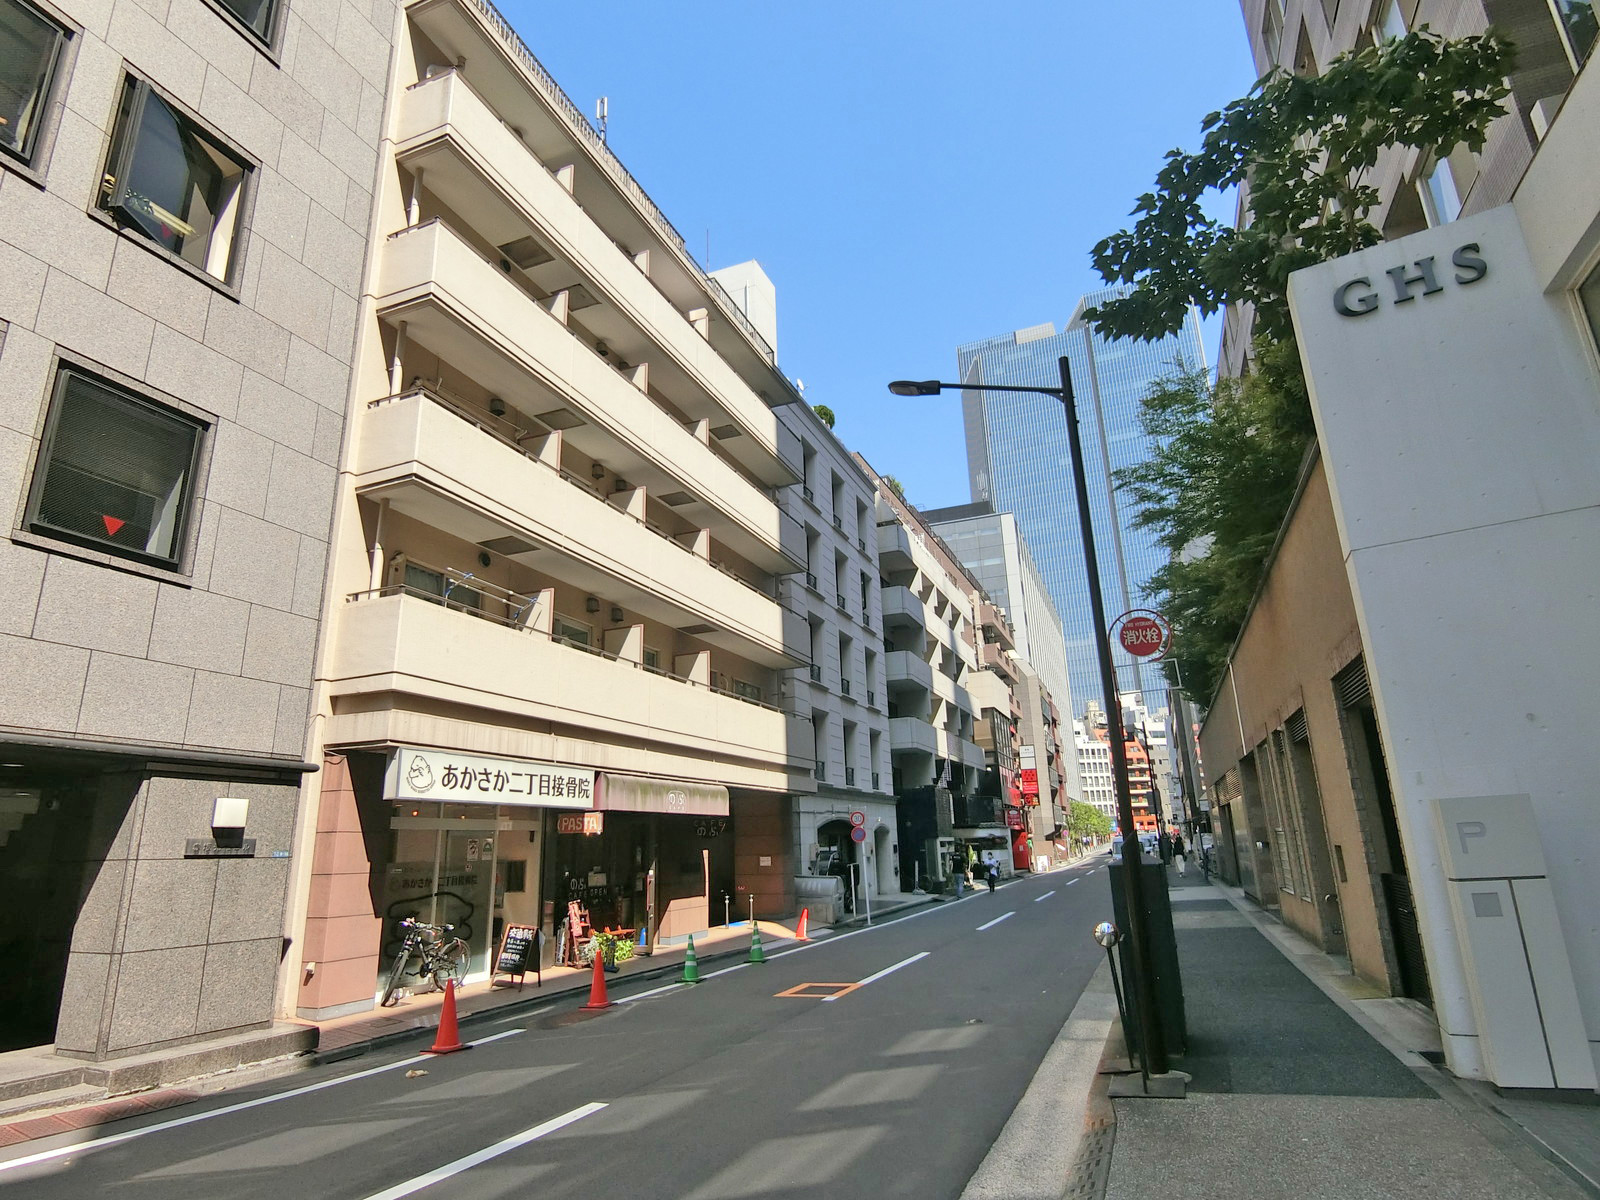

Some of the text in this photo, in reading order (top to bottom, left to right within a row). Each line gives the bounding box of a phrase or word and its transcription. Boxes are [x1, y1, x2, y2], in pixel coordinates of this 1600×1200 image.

[1333, 242, 1488, 317] GHS
[1123, 627, 1160, 645] 消火栓
[441, 764, 591, 799] あかさか二丁目接骨院
[561, 817, 598, 831] PASTA
[1456, 821, 1487, 854] P
